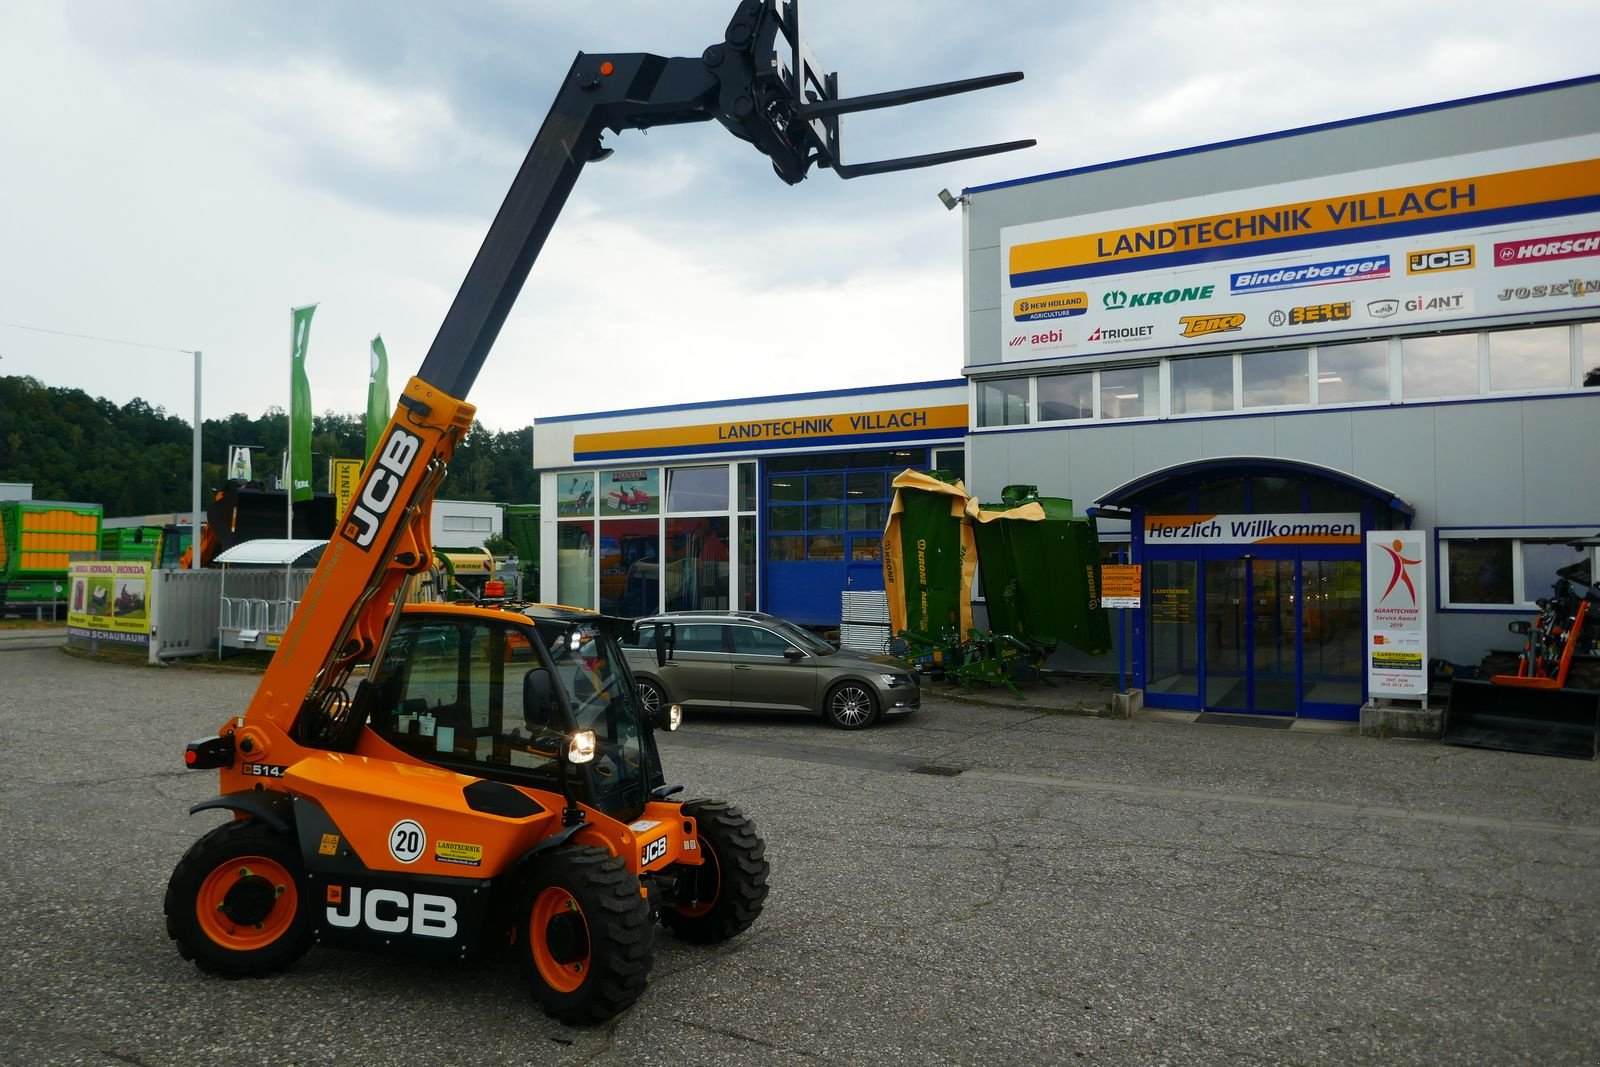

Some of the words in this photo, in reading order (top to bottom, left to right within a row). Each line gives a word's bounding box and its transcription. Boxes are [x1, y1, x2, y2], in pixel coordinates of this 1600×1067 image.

[1097, 207, 1312, 258] LANDTECHNIK
[1326, 184, 1476, 226] VILLACH
[1516, 237, 1600, 259] HORSCH
[1411, 251, 1470, 271] JCB
[1235, 259, 1386, 287] Binderberger
[1030, 302, 1047, 310] NEW
[1048, 297, 1082, 309] HOLLAND
[1129, 285, 1215, 308] KRONE
[1030, 310, 1070, 320] AGRICULTURE
[1179, 313, 1246, 338] Tanco
[1031, 329, 1063, 345] aebi
[1101, 325, 1154, 340] TRIOLIET
[718, 417, 834, 440] LANDTECHNIK
[849, 411, 927, 431] VILLACH
[612, 470, 648, 480] HONDA
[353, 429, 420, 547] JCB
[1150, 521, 1222, 538] Herzlich
[1230, 520, 1356, 538] Willkommen
[89, 565, 112, 573] HONDA
[117, 566, 145, 574] HONDA
[885, 551, 895, 584] KRONE
[918, 550, 927, 585] KRONE
[1086, 565, 1097, 599] KRONE
[395, 830, 419, 853] 20
[438, 842, 481, 853] LANDTECHNIK
[641, 836, 667, 866] JCB
[326, 885, 458, 939] JCB
